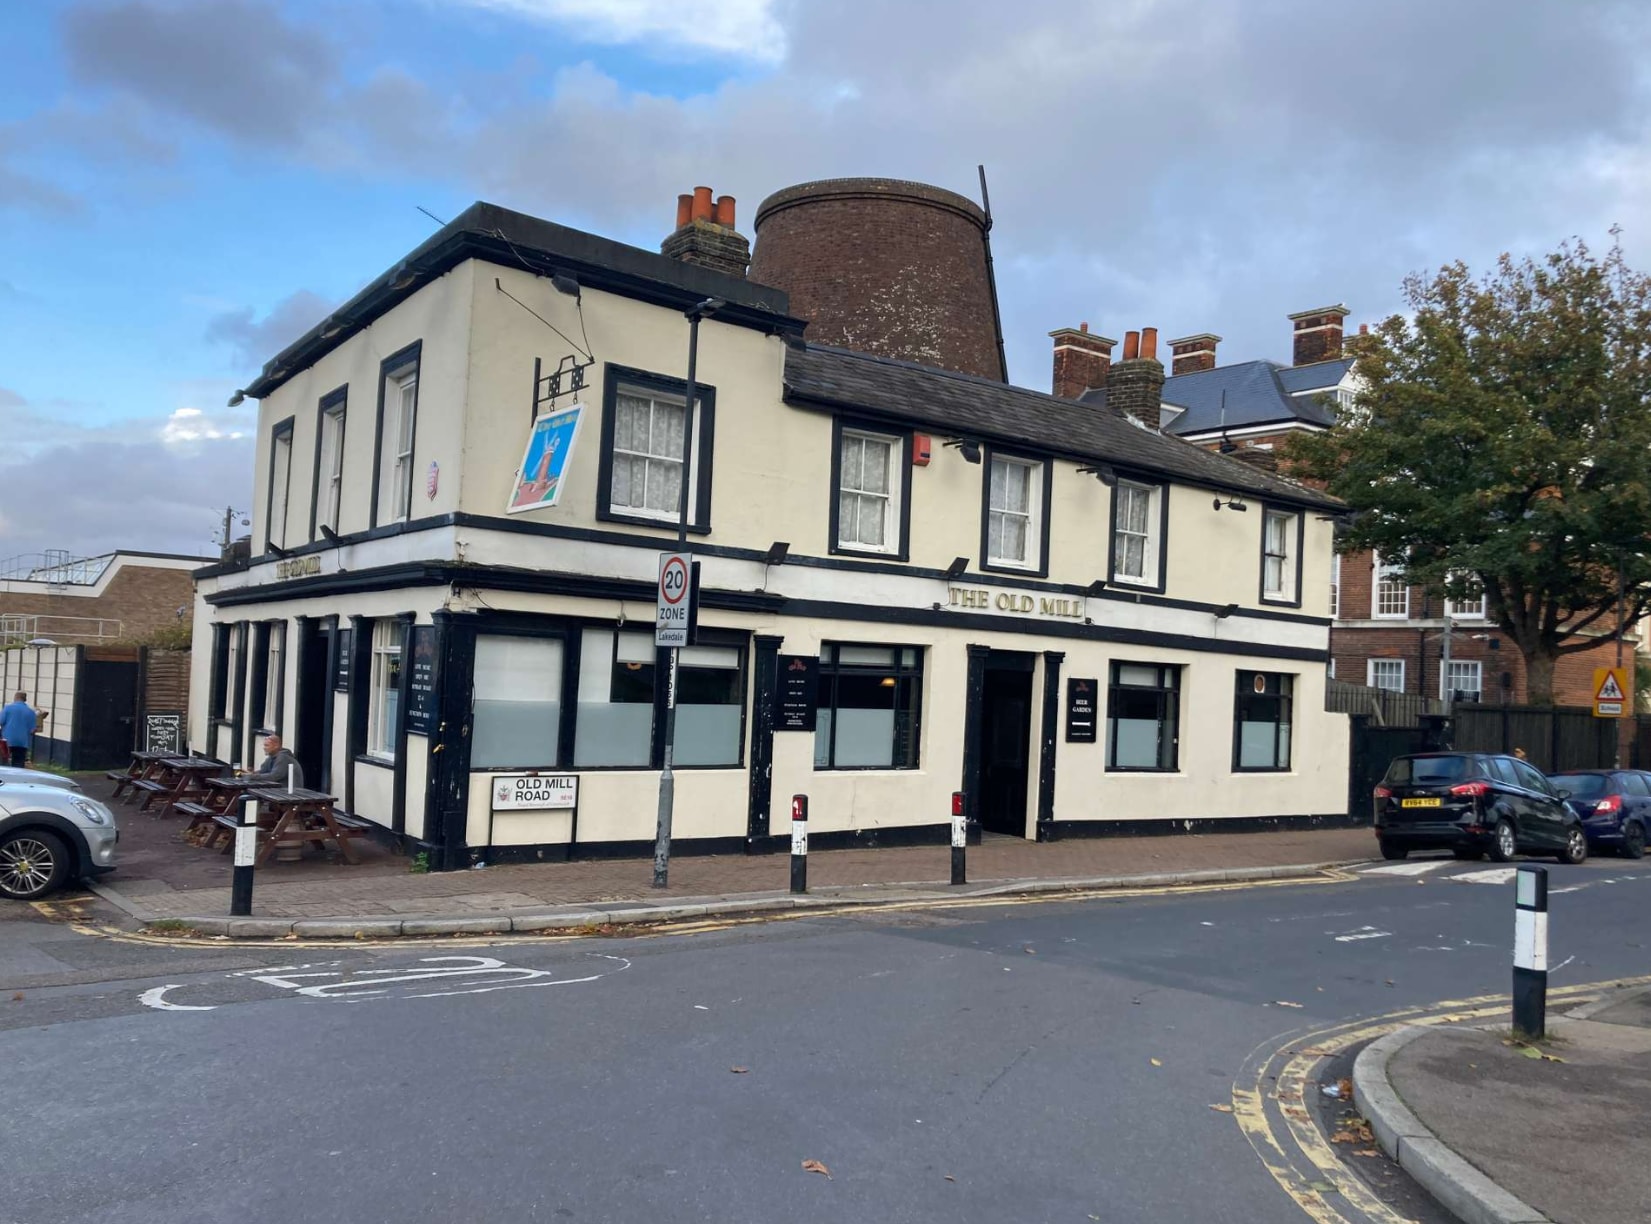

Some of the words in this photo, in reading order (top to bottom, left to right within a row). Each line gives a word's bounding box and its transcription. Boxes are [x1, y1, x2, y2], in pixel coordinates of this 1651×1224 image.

[665, 570, 683, 589] 20
[949, 587, 989, 608] THE
[995, 592, 1034, 613] OLD
[1040, 597, 1082, 618] MILL
[660, 607, 685, 620] ZONE
[658, 632, 683, 641] Lakedale
[516, 778, 542, 789] OLD
[545, 778, 573, 789] MILL
[515, 790, 551, 801] ROAD
